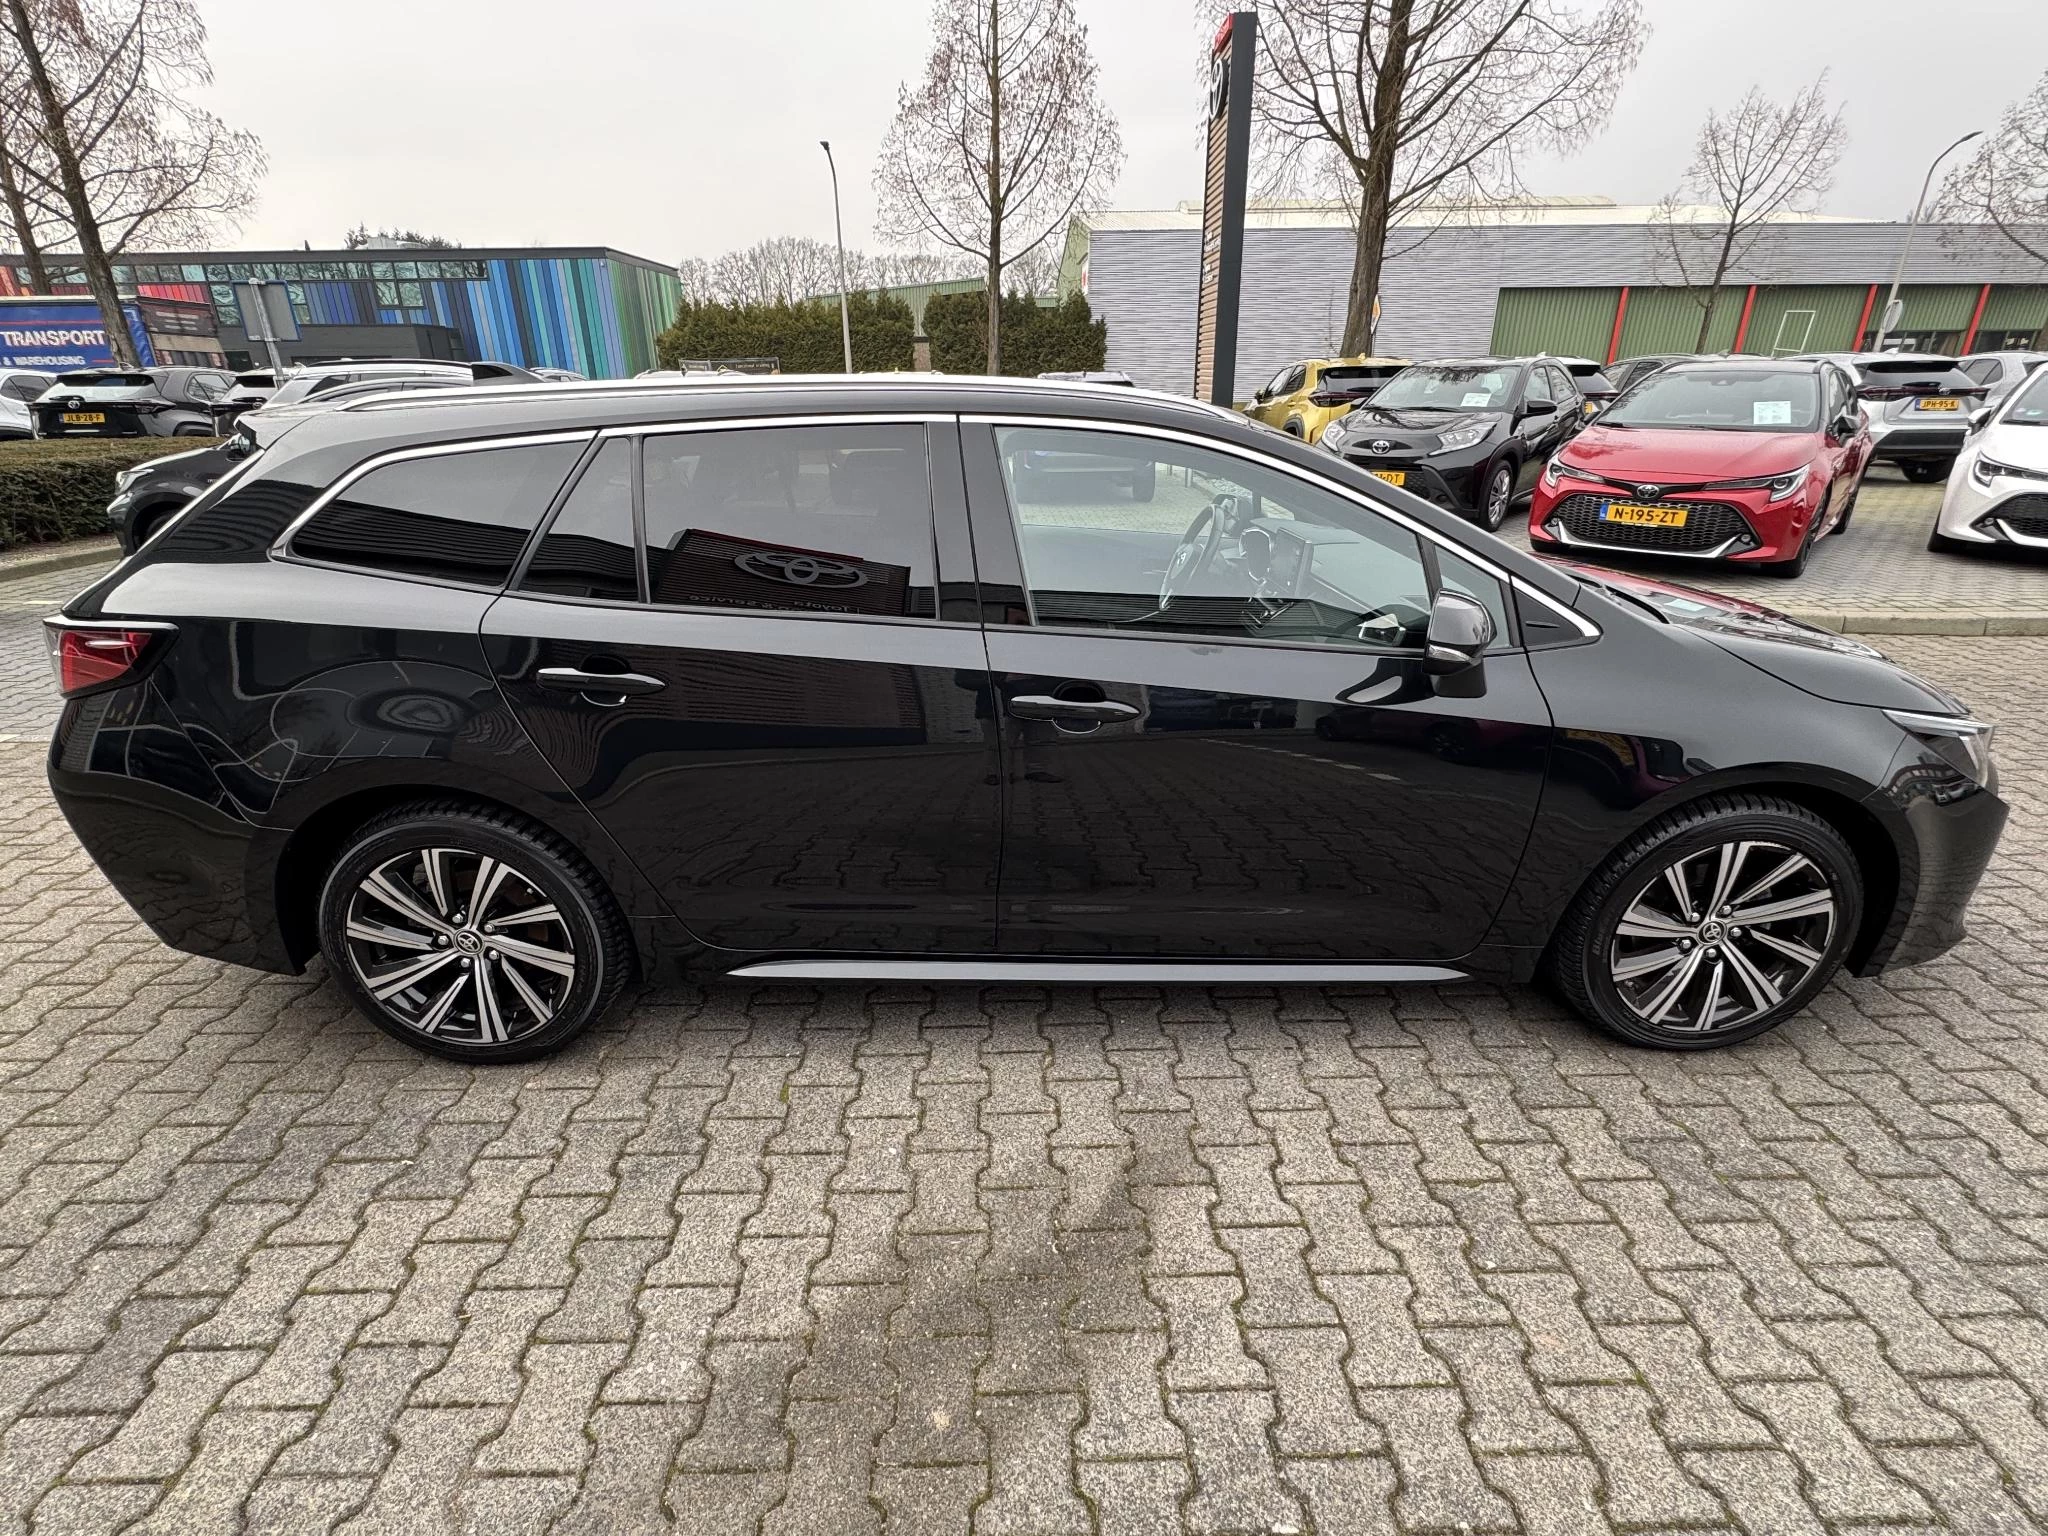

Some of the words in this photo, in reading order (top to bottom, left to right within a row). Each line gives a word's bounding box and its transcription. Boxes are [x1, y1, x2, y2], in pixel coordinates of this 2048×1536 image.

[0, 330, 106, 347] TRANSPORT
[3, 356, 13, 366] &
[13, 355, 86, 366] WAREHOUSING
[1613, 507, 1679, 524] N-195-ZT
